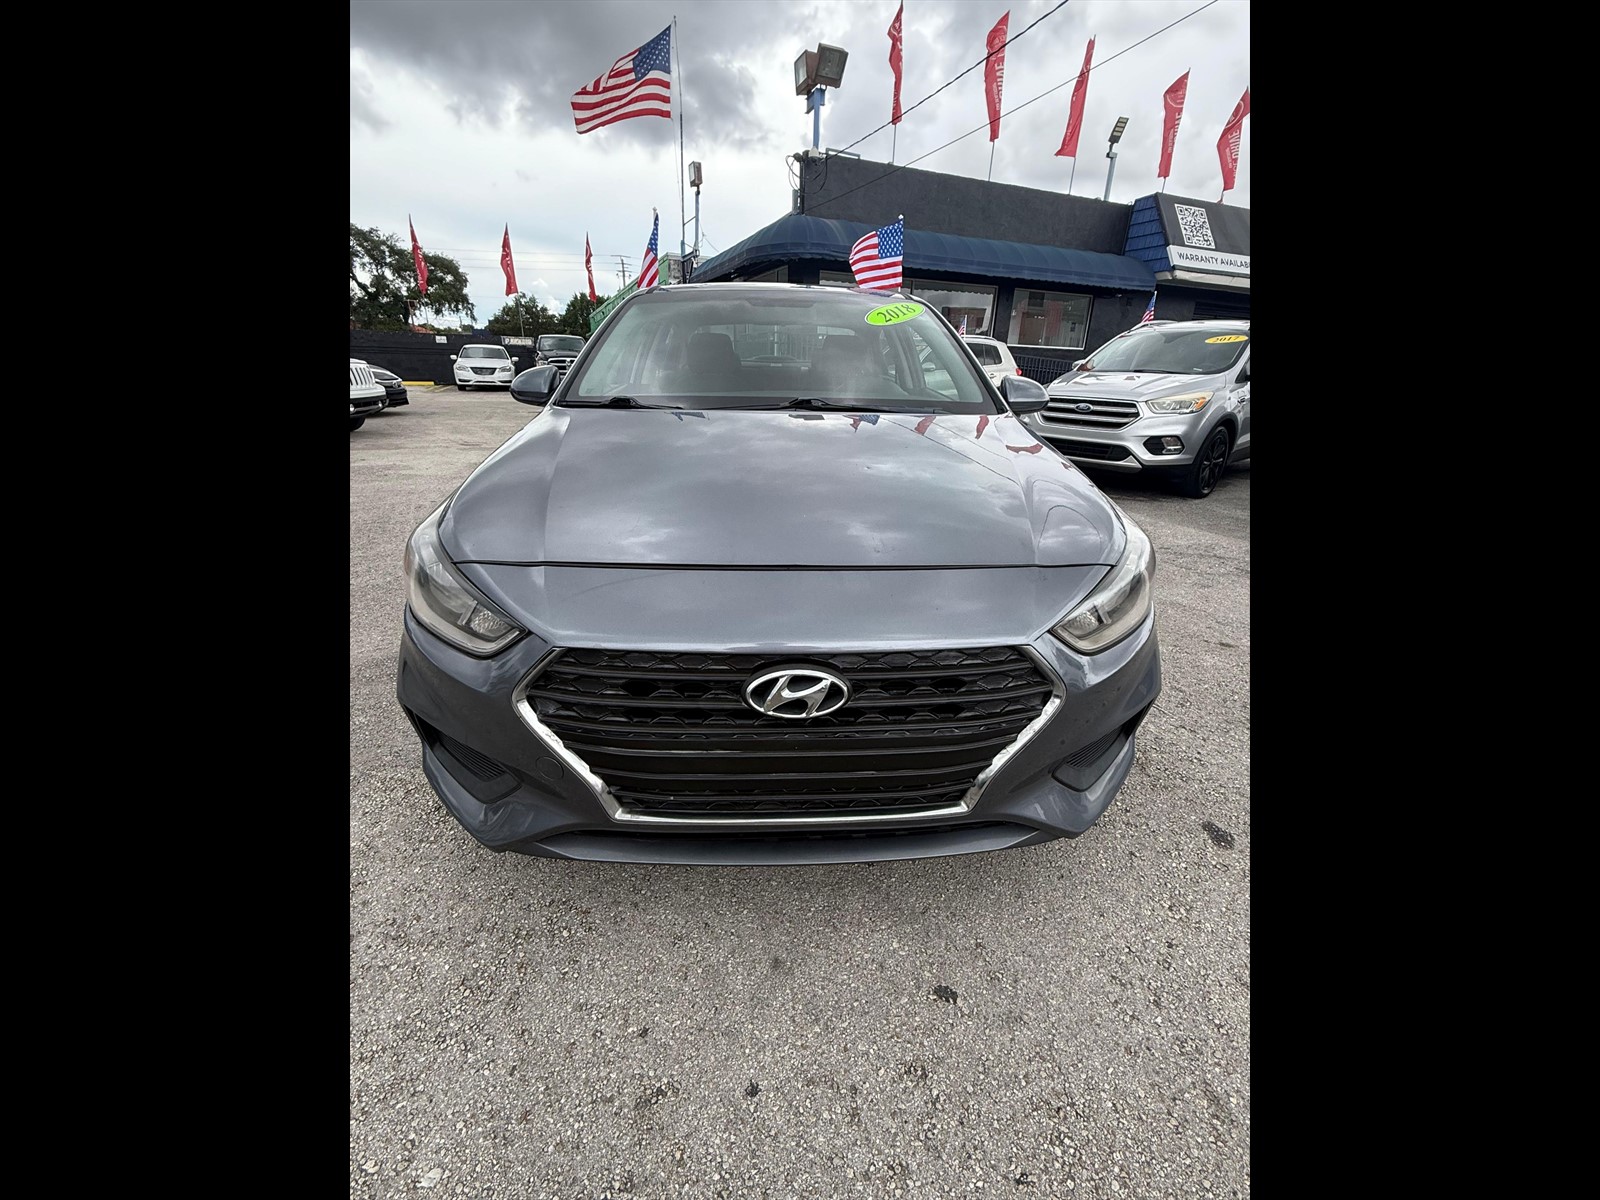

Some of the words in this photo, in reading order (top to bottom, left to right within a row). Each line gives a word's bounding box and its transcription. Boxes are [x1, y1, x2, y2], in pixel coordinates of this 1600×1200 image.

[1177, 251, 1218, 265] WARRANTY
[1220, 258, 1250, 269] AVAILAB
[876, 304, 916, 323] 2018
